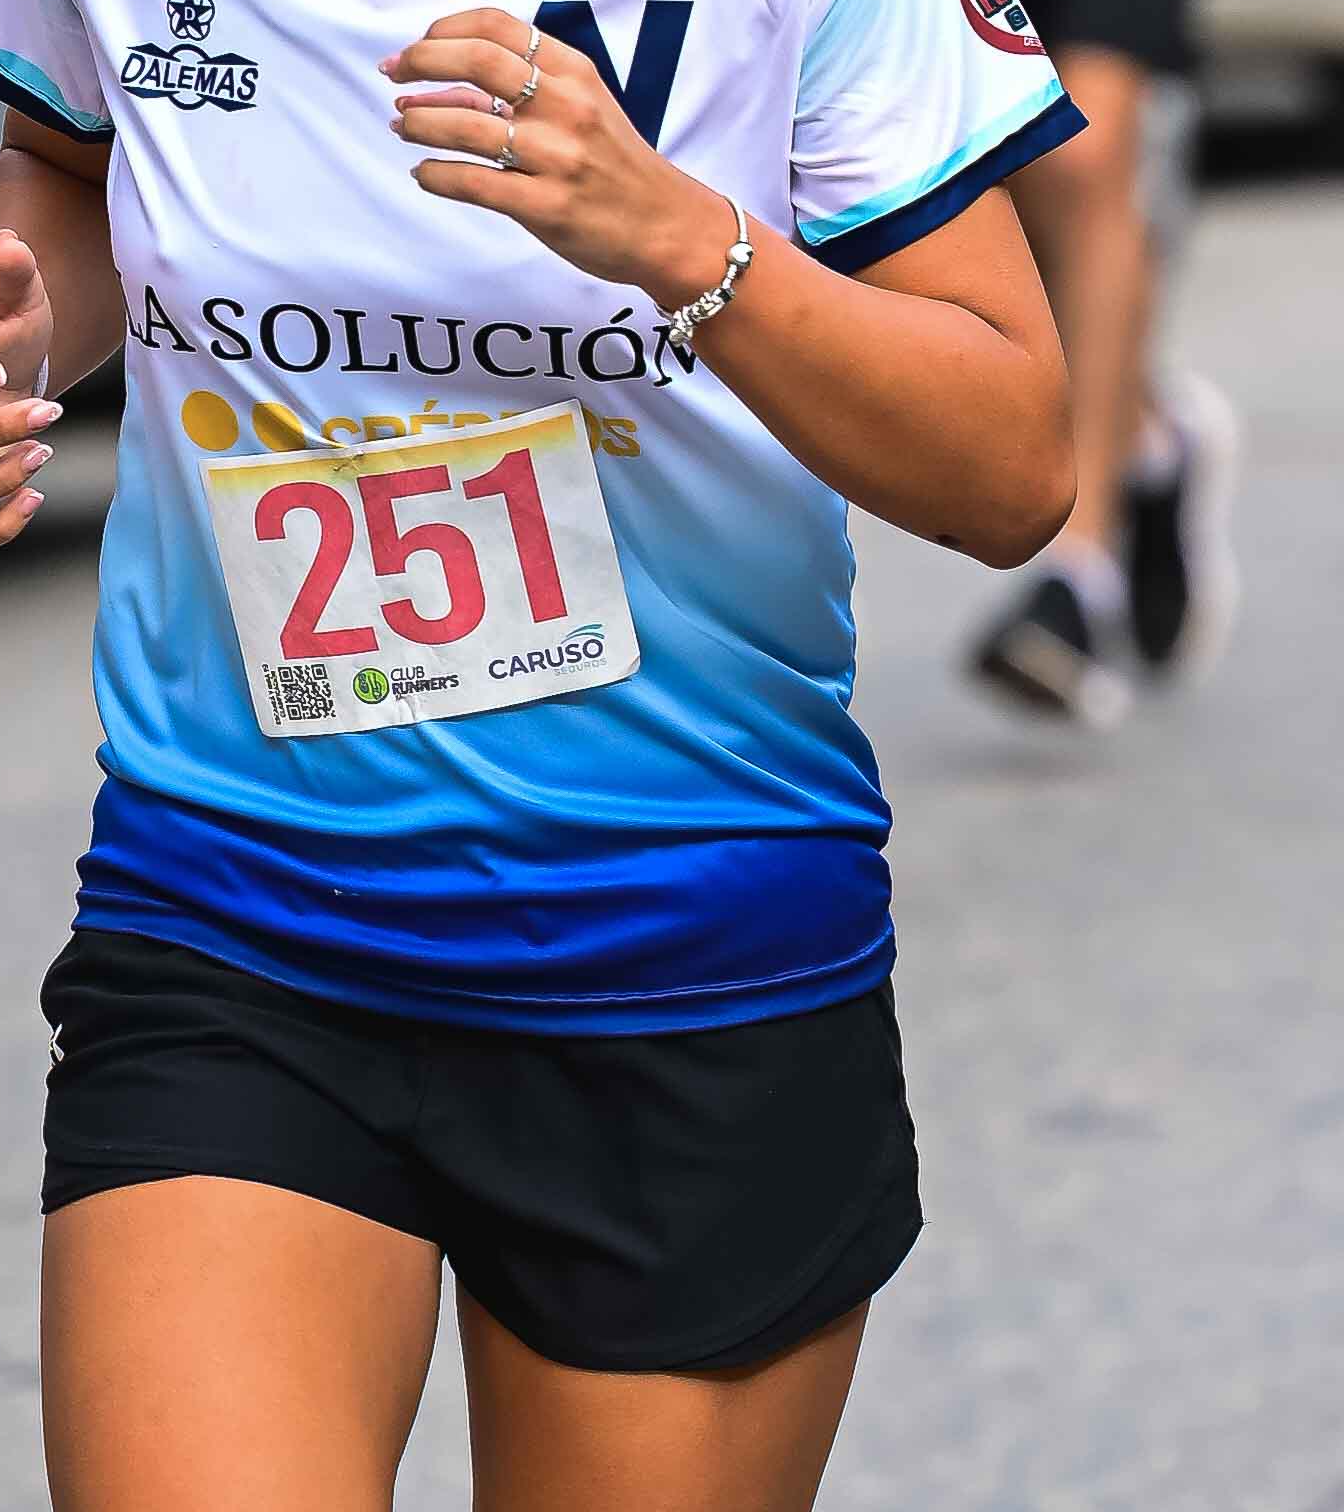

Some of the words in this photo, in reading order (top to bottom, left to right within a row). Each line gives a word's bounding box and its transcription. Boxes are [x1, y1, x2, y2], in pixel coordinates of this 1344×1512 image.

[120, 52, 259, 101] DALEMAS
[202, 296, 698, 388] SOLUCIÓN
[254, 447, 569, 660] 251
[390, 666, 425, 682] CLUB
[488, 638, 604, 680] CARUSO
[553, 657, 608, 676] SEGUROS
